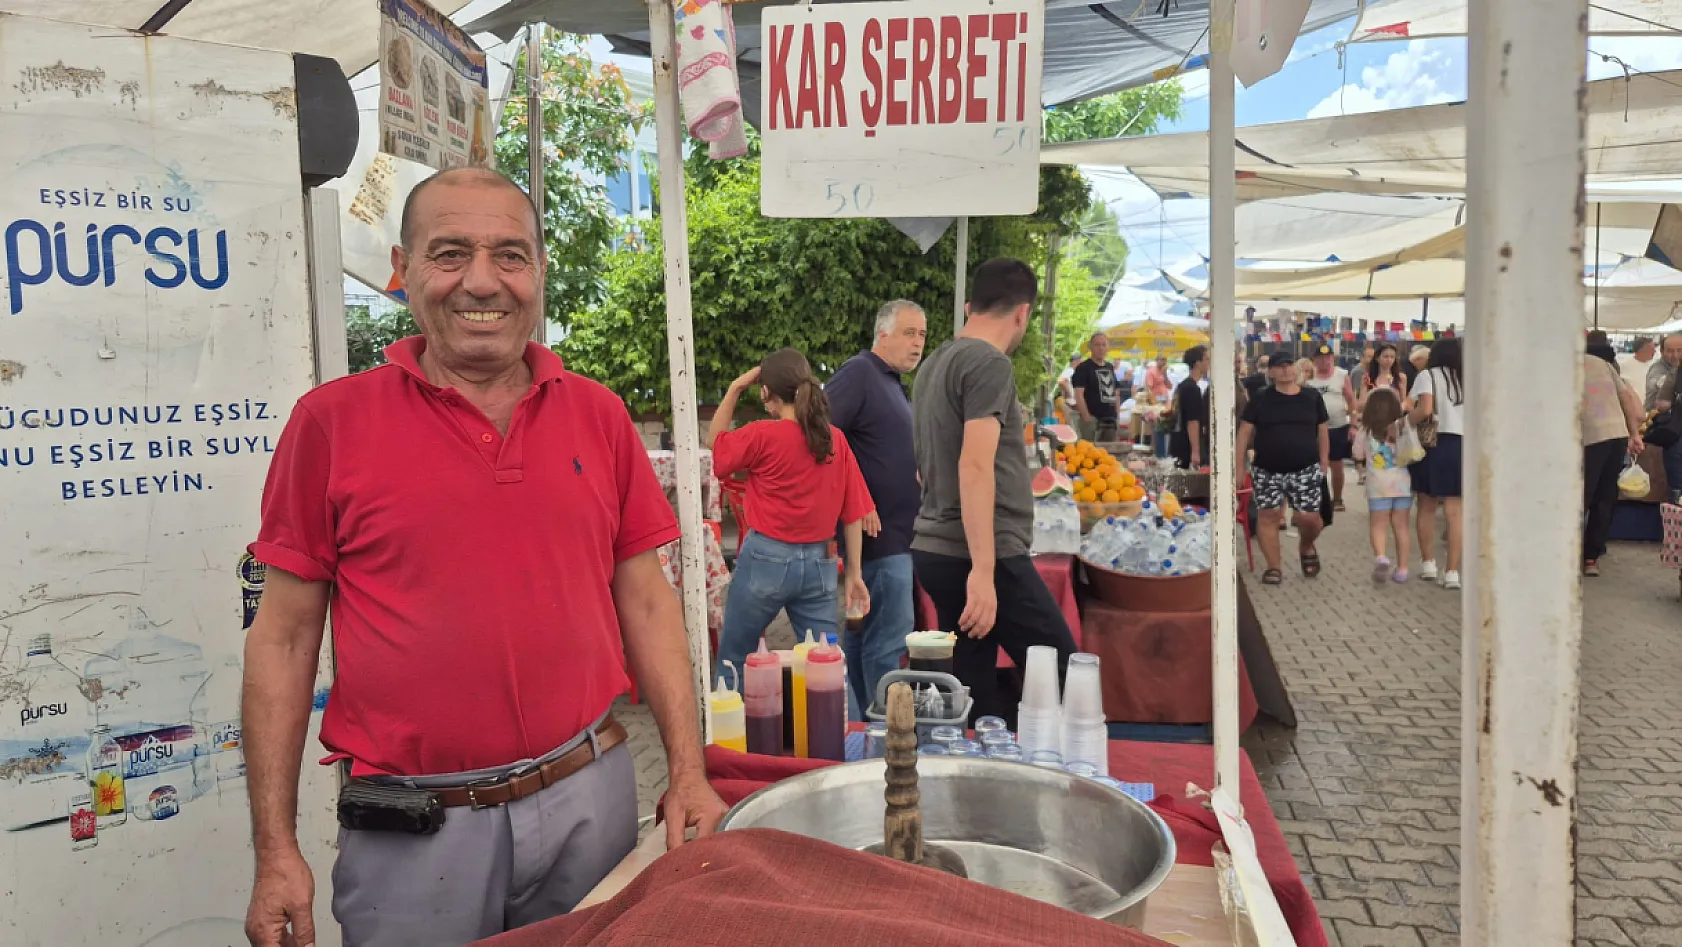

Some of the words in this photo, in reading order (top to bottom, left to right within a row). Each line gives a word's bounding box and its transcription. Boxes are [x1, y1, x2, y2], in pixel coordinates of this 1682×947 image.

[768, 21, 848, 131] KAR
[859, 11, 1029, 138] ŞERBETİ
[39, 187, 107, 209] EŞSİZ
[117, 191, 153, 211] BİR
[163, 196, 191, 212] SU
[826, 182, 875, 215] 50
[5, 218, 229, 316] pürsu
[194, 398, 278, 426] EŞSİZ.
[51, 438, 136, 469] EŞSİZ
[149, 435, 193, 459] BİR
[206, 435, 274, 455] SUYL
[61, 469, 213, 500] BESLEYİN.
